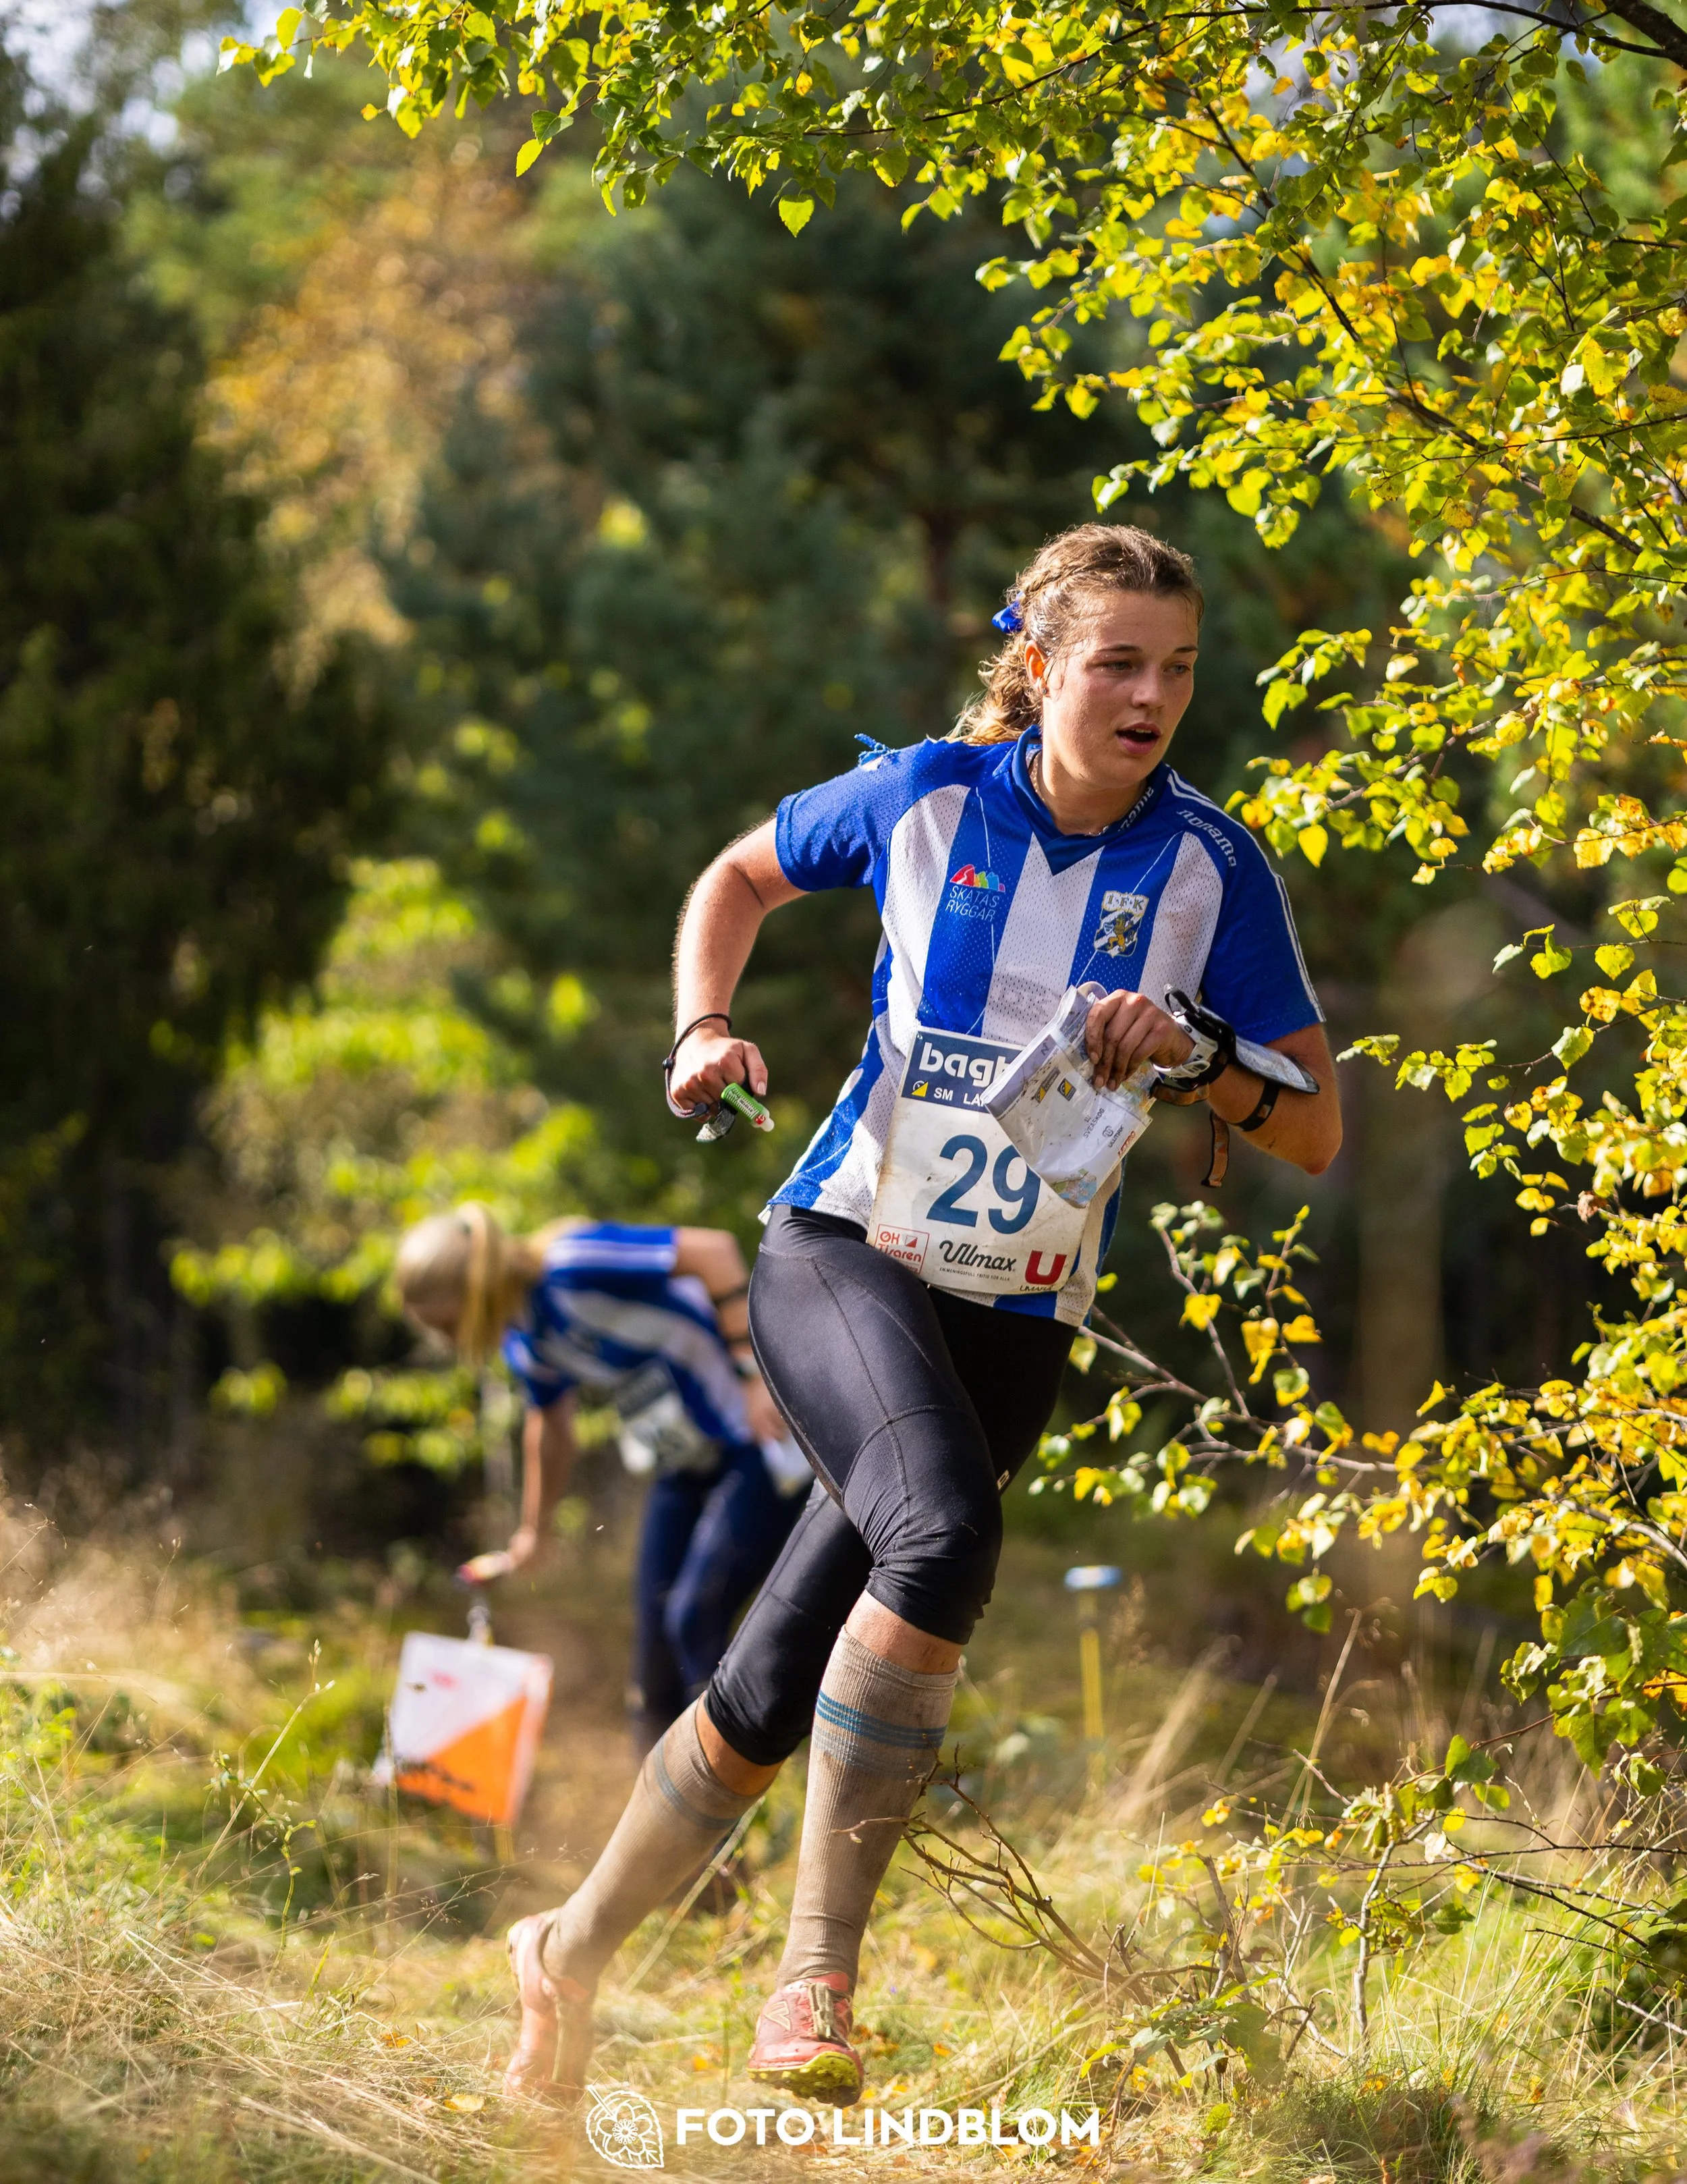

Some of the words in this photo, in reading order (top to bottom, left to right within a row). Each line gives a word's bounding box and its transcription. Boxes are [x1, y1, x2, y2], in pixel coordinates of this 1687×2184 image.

[945, 899, 996, 922] RYGGAR
[933, 1087, 953, 1101] SM
[1083, 1108, 1105, 1139] SVEASKOG
[926, 1134, 1041, 1234] 29
[939, 1240, 1016, 1272] Ullmax
